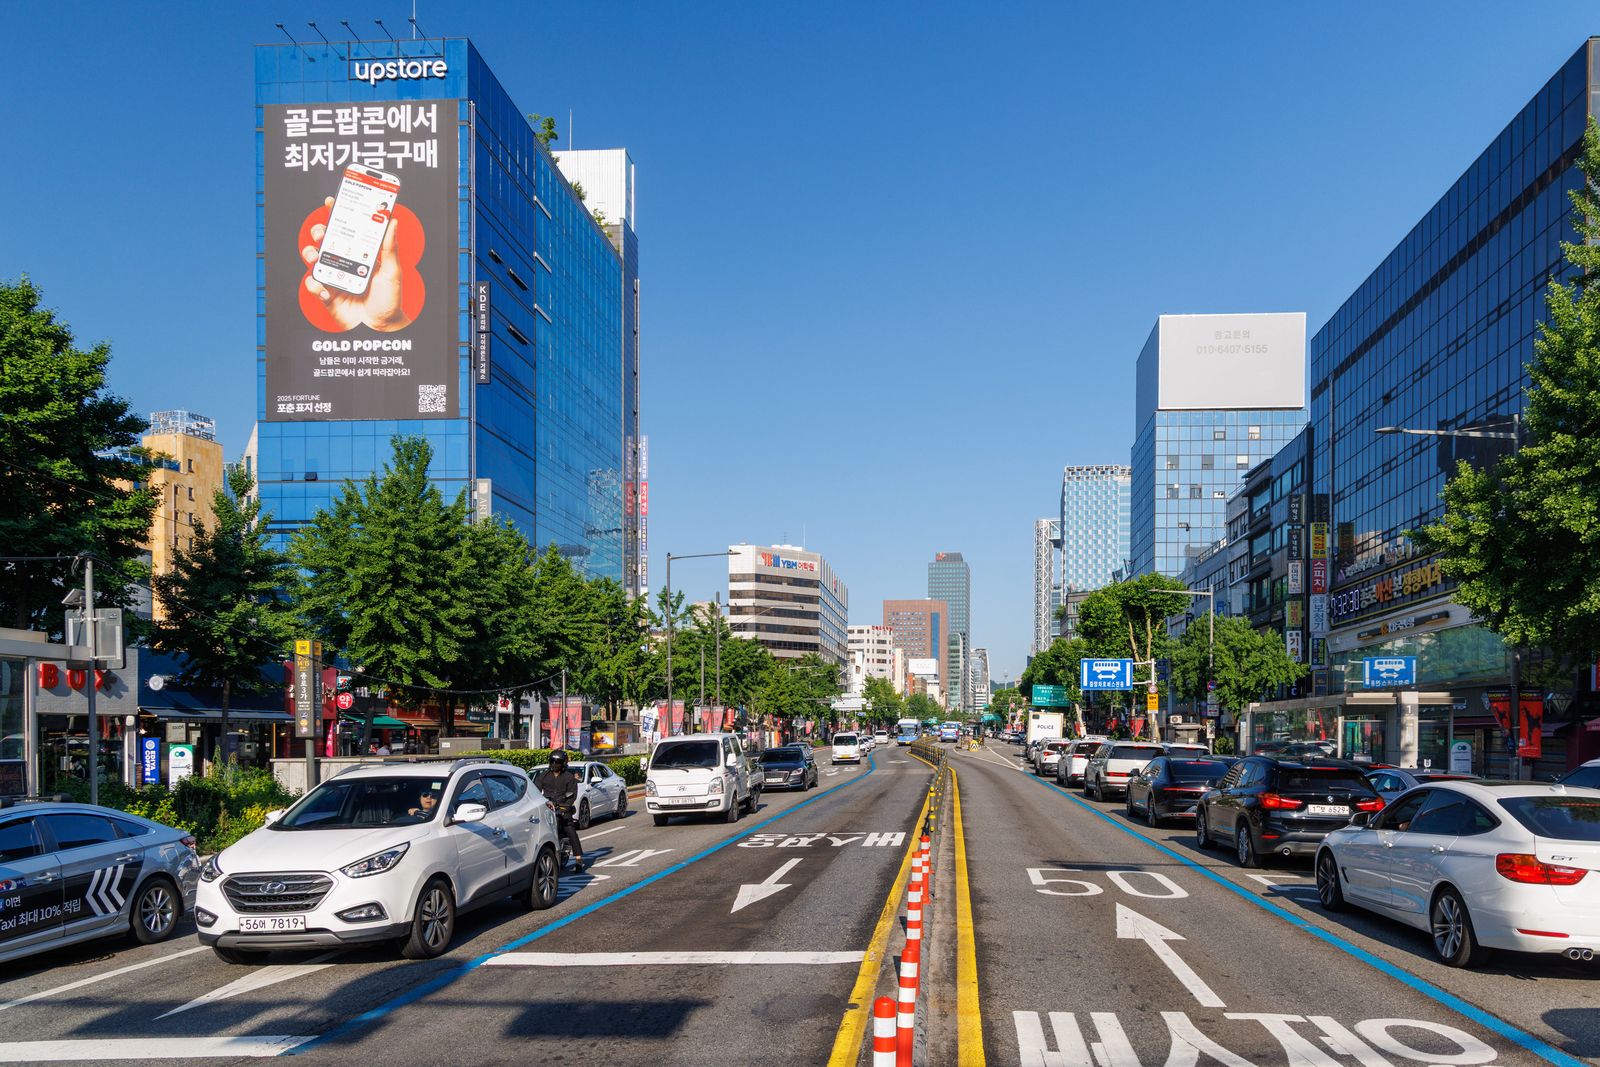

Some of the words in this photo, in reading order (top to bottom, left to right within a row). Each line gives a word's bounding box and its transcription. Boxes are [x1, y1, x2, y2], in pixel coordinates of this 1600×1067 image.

[355, 59, 447, 85] upstore
[284, 104, 437, 138] 골드팝콘에서
[284, 139, 438, 171] 최저가금구매
[312, 340, 351, 351] GOLD
[353, 340, 412, 351] POPCON
[319, 357, 341, 365] 남들은
[342, 356, 357, 365] 이미
[358, 356, 379, 365] 시작한
[313, 368, 356, 377] 골드팝콘에서
[357, 368, 372, 377] 쉽게
[373, 367, 411, 377] 따라잡아요!
[277, 403, 295, 413] 포춘
[295, 403, 313, 413] 표지
[314, 402, 332, 413] 선정
[300, 672, 308, 700] 종로3가
[339, 695, 351, 707] 약
[737, 832, 906, 848] 버스전용
[1026, 867, 1189, 899] 50
[5, 896, 21, 908] 이면
[0, 916, 17, 930] axi
[18, 908, 39, 926] 최대
[40, 905, 61, 920] 10%
[63, 898, 81, 913] 적립
[246, 919, 266, 930] 56어
[271, 918, 299, 929] 7819
